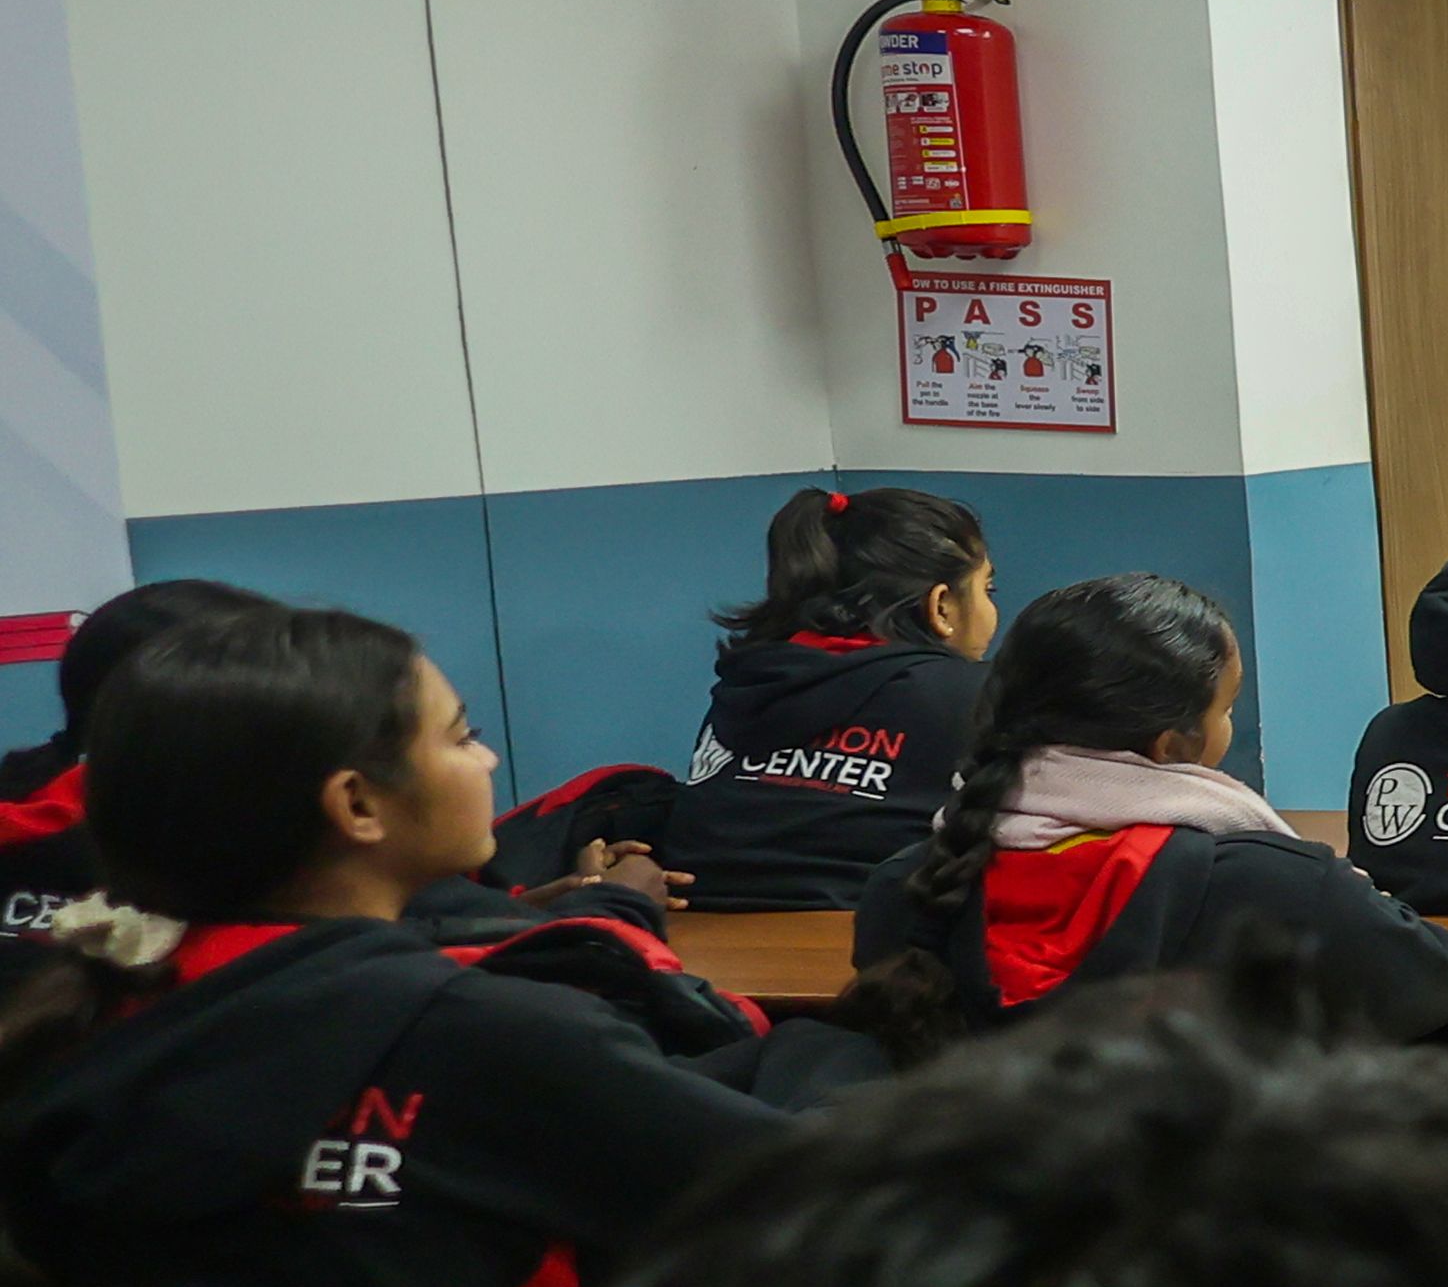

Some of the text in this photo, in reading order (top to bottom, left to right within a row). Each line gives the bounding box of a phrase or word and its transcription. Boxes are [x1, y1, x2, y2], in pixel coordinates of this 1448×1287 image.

[913, 279, 1104, 296] OW TO USE A FIRE EXTINGUISHER
[915, 297, 1094, 329] P A S S
